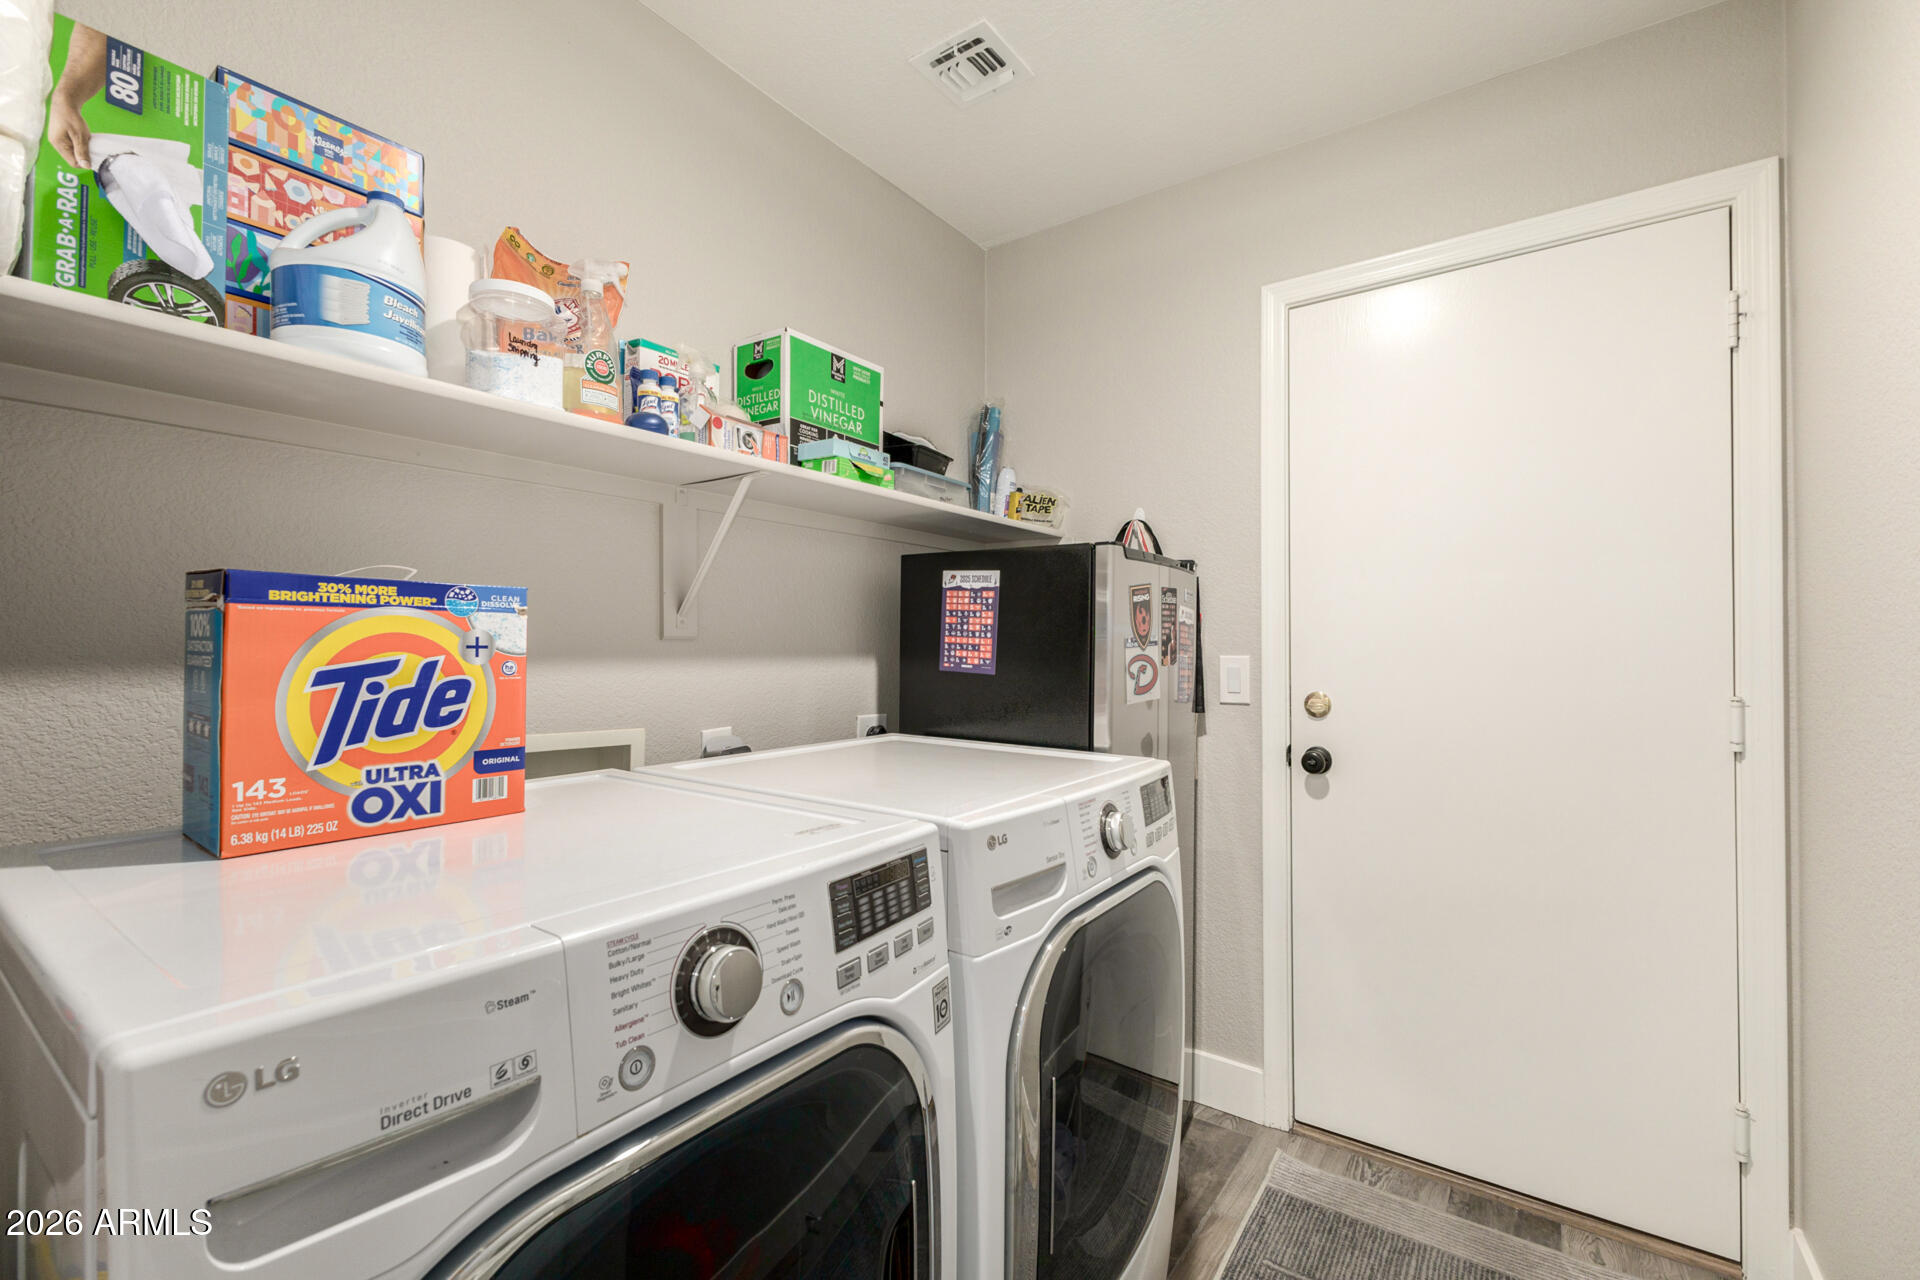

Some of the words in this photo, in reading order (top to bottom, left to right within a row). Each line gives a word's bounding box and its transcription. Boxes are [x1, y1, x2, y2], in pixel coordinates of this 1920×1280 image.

[110, 71, 139, 105] 80
[311, 136, 344, 156] Kleenex
[383, 295, 419, 318] Bleach
[658, 355, 669, 367] 20
[737, 388, 781, 408] DISTILLED
[808, 389, 865, 421] DISTILLED
[810, 406, 863, 436] VINEGAR
[1025, 504, 1051, 514] TAPE
[268, 589, 378, 605] BRIGHTENING
[317, 582, 351, 594] 30%
[355, 584, 397, 596] MORE
[490, 594, 520, 603] CLEAN
[305, 655, 475, 772] Tide
[482, 756, 520, 766] ORIGINAL
[365, 763, 440, 784] ULTRA
[232, 778, 287, 802] 143
[351, 780, 442, 824] OXI
[230, 832, 254, 846] 6.38
[256, 832, 269, 844] kg
[271, 828, 287, 842] (14
[289, 824, 305, 838] LB)
[307, 823, 324, 835] 225
[326, 820, 339, 833] OZ
[997, 833, 1009, 845] LG
[607, 938, 624, 949] STEAM
[624, 932, 639, 943] CYCLE
[607, 938, 652, 958] Cotton/Normal
[608, 953, 645, 970] Bulky/Large
[609, 973, 630, 985] Heavy
[630, 968, 645, 978] Duty
[610, 987, 630, 1000] Bright
[612, 1002, 639, 1016] Sanitary
[936, 998, 948, 1023] 10
[616, 1040, 628, 1049] Tub
[628, 1032, 645, 1042] Clean
[254, 1056, 300, 1091] LG
[380, 1092, 428, 1115] Inverter
[380, 1102, 429, 1130] Direct
[433, 1087, 472, 1111] Drive
